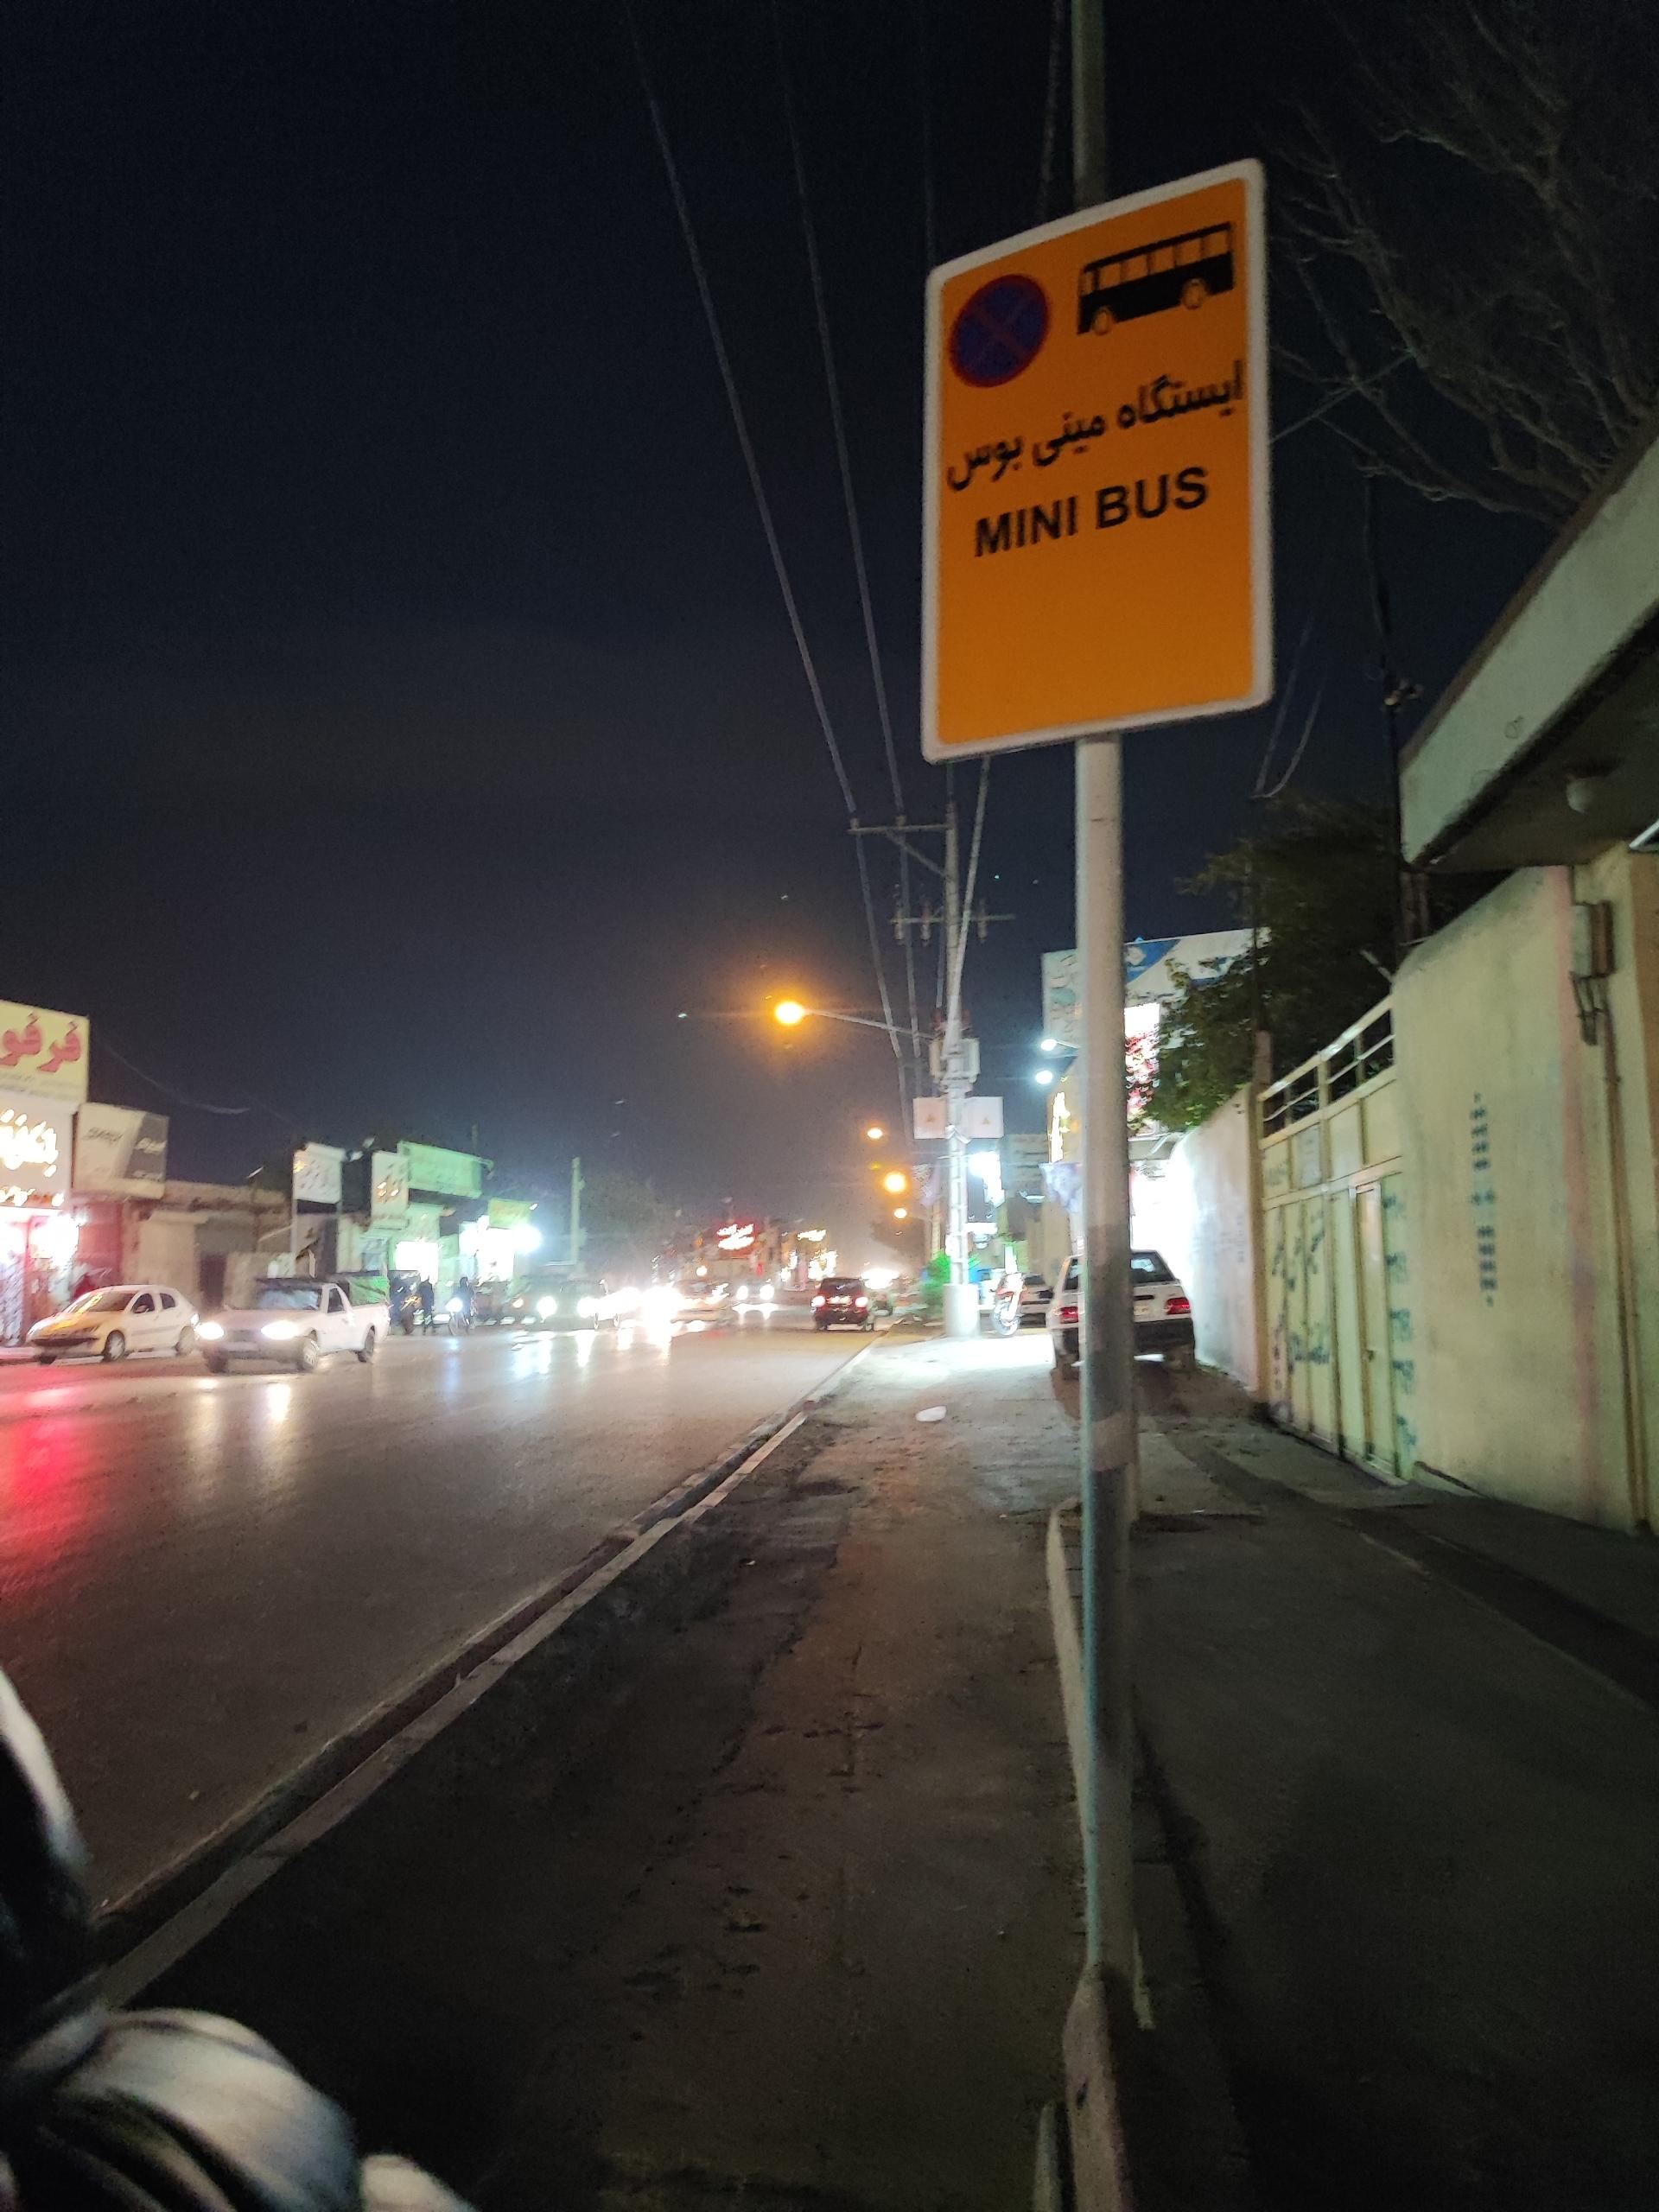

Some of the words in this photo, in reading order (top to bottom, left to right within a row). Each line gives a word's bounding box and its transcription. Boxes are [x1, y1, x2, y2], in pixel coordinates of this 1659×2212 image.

[1116, 359, 1245, 429] ایستگاه
[947, 435, 1025, 492] بوس
[1033, 411, 1107, 467] مینی
[975, 495, 1079, 557] MINI
[1096, 467, 1209, 530] BUS
